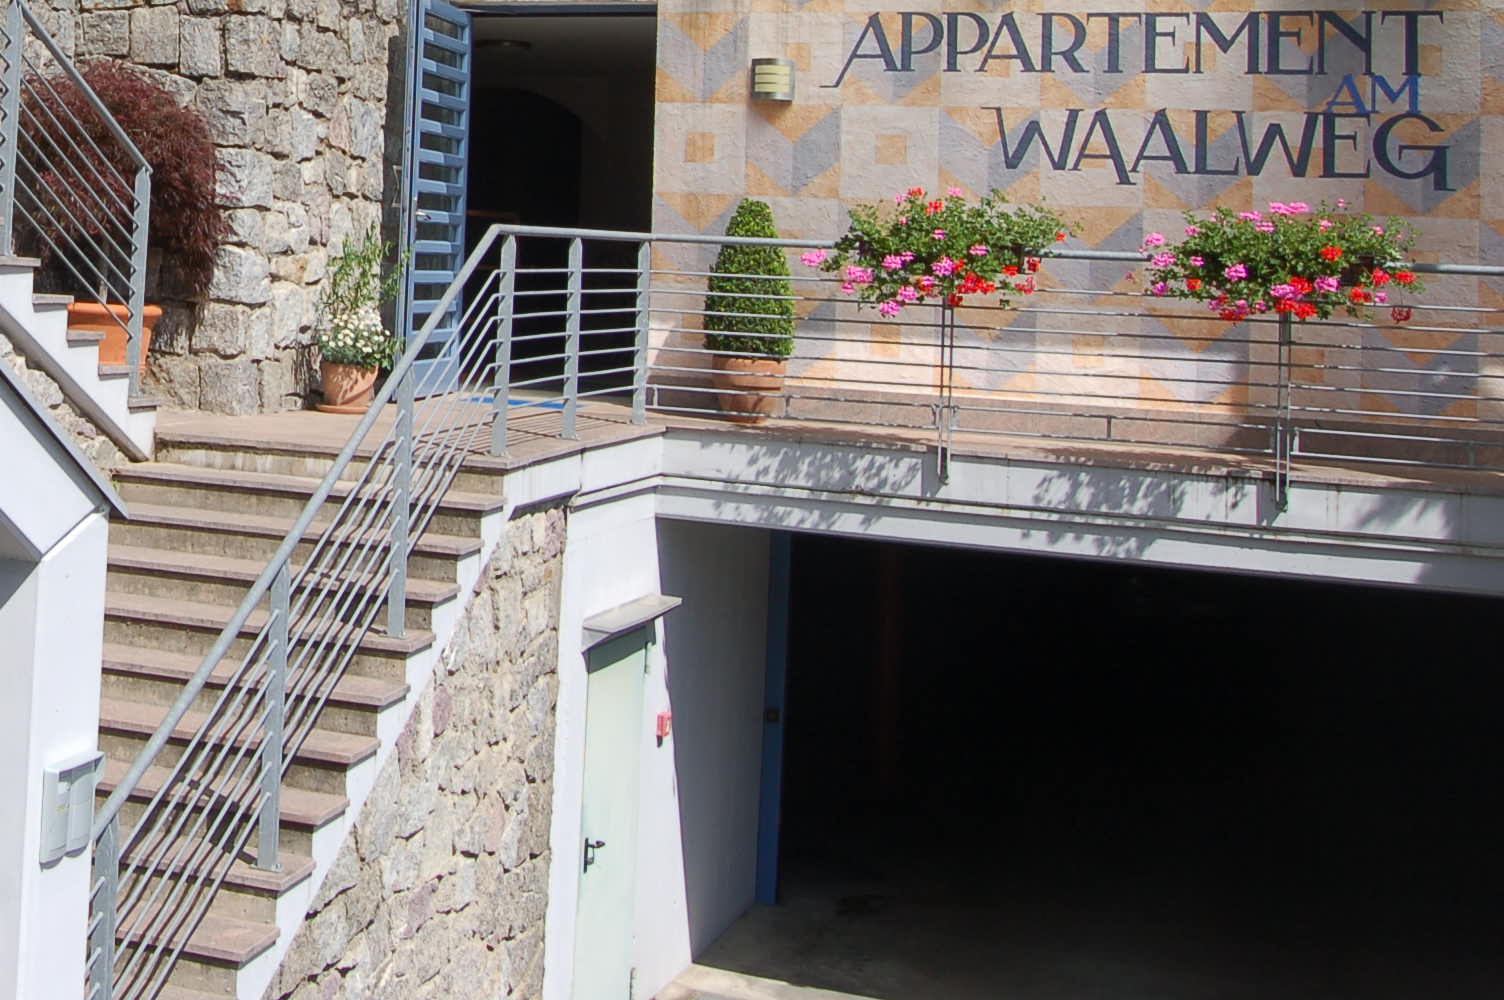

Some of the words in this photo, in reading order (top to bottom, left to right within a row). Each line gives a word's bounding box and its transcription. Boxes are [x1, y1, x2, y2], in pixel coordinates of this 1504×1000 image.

[819, 10, 1444, 88] APPARTEMENT
[1325, 73, 1422, 115] AM
[980, 106, 1457, 192] WAALWEG
